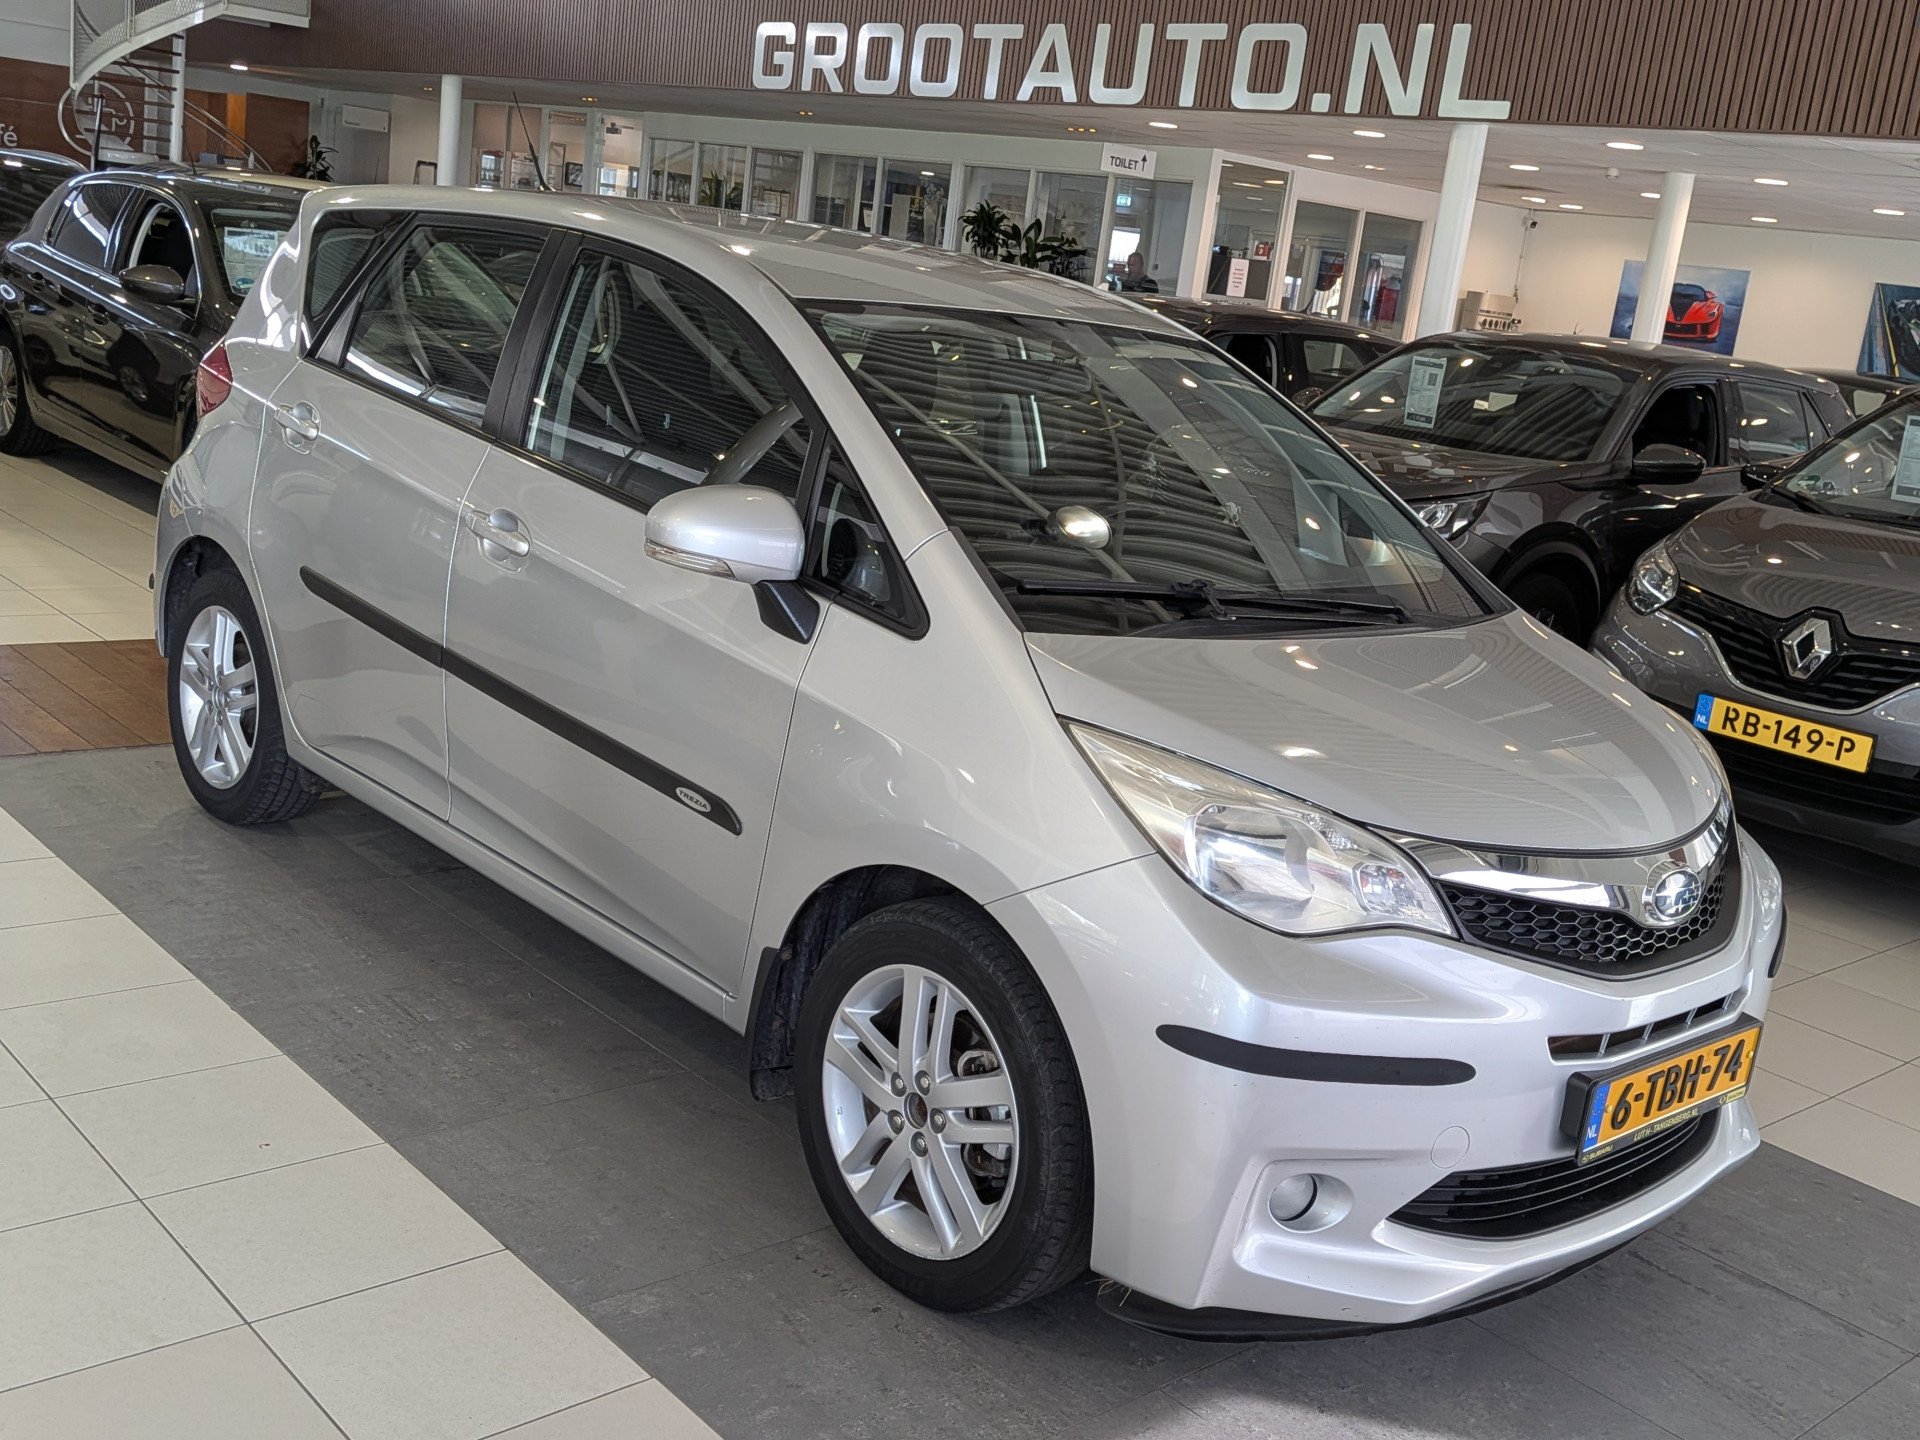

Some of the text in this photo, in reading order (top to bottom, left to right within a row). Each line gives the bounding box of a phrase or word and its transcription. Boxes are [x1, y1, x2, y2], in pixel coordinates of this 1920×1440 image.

[752, 22, 1511, 119] GROOTAUTO.NL
[1110, 155, 1139, 170] TOILET
[1696, 714, 1708, 725] NL
[1721, 705, 1856, 761] RB-149-P
[678, 789, 708, 810] TREZIA
[1610, 1038, 1746, 1131] 6-TBH-74
[1586, 1123, 1597, 1140] NL
